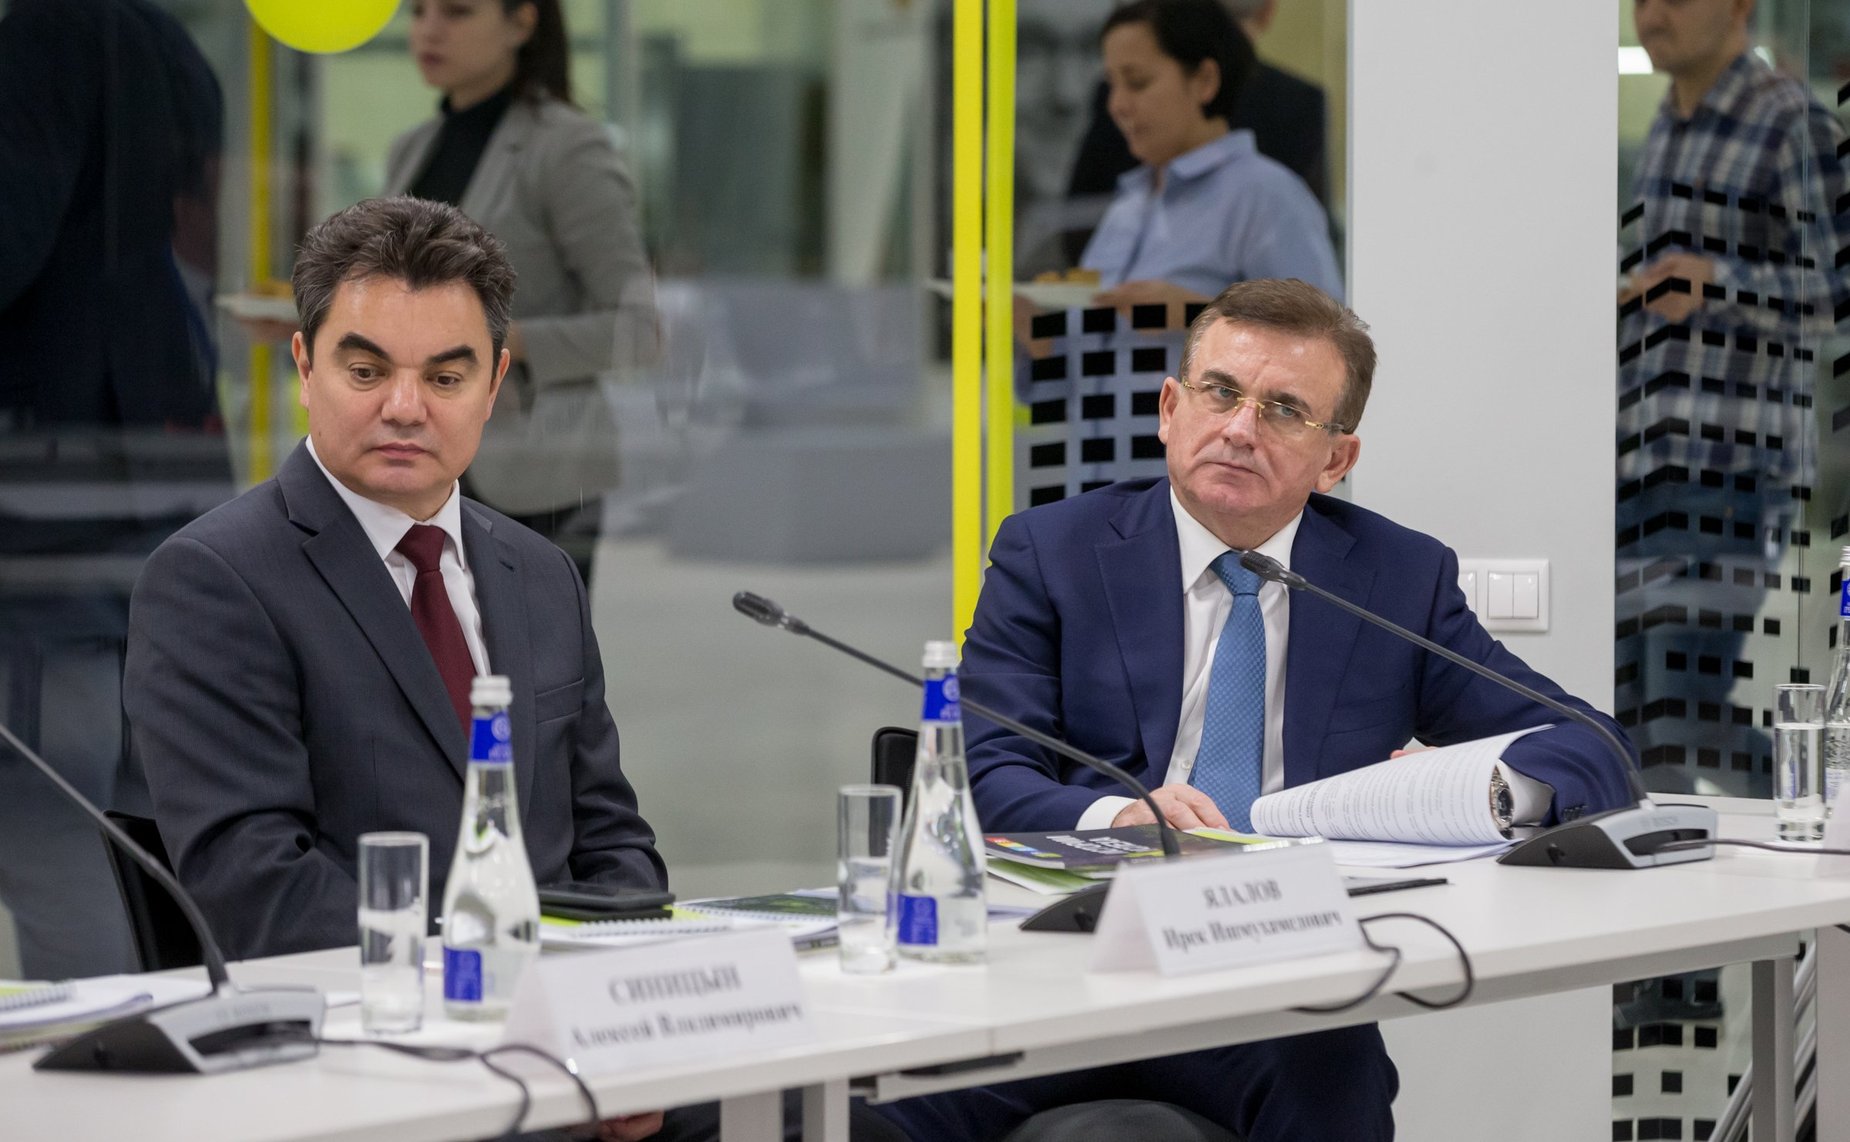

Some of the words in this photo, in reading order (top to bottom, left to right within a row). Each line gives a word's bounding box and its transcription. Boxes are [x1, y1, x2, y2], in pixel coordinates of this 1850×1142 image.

[1203, 879, 1282, 908] ЯЛАЛОВ
[1163, 926, 1208, 951] Ирек
[609, 964, 741, 1004] СИНИЦЫН
